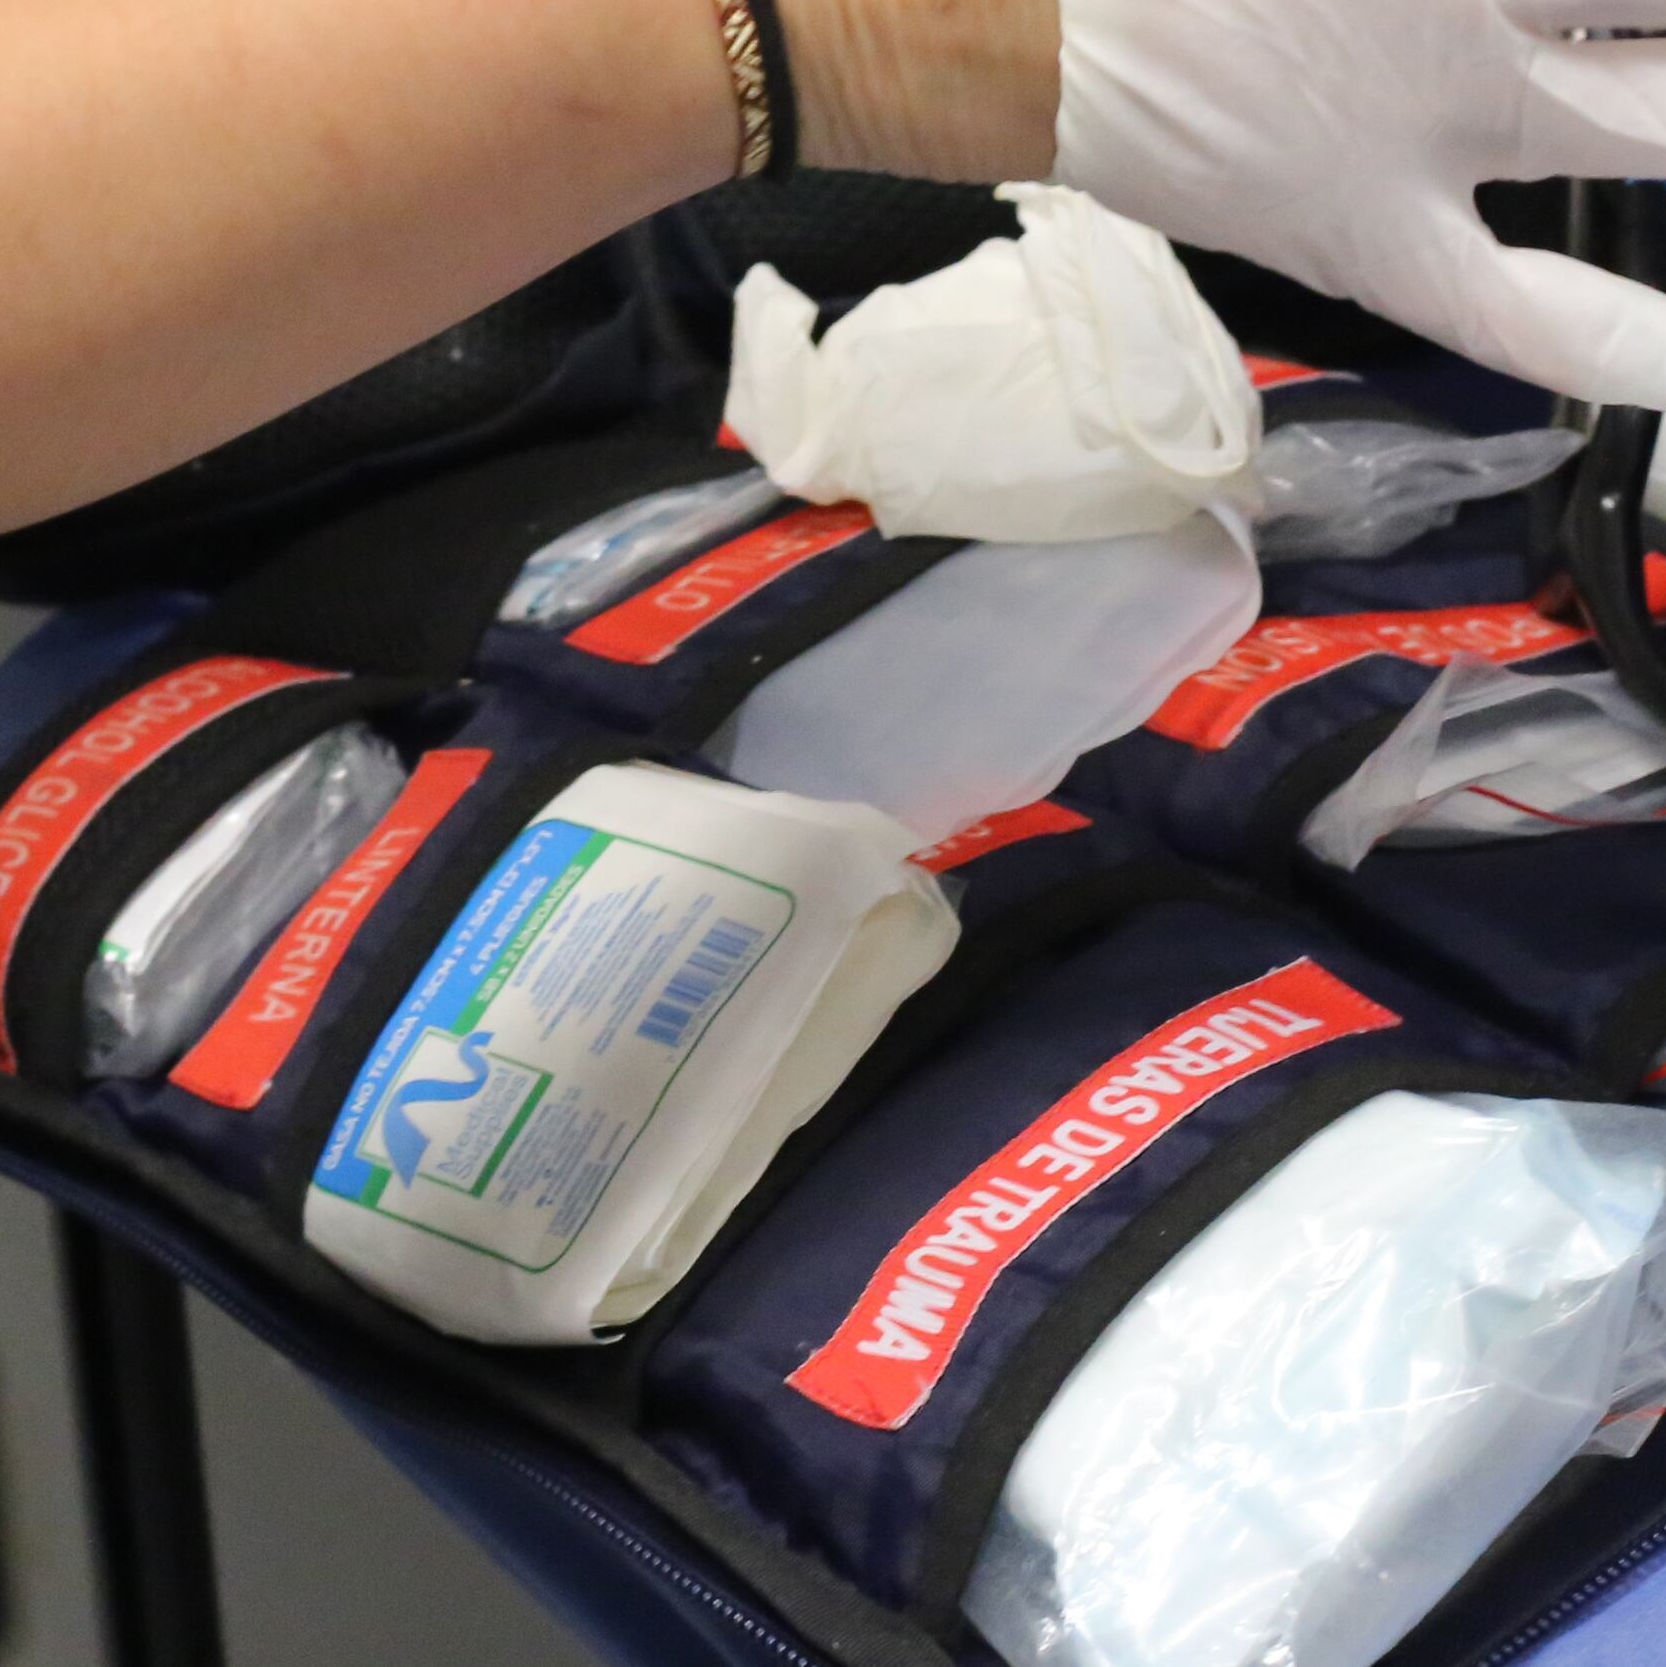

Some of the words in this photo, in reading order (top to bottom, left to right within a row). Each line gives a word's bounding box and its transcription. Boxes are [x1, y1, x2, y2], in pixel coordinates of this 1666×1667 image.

[247, 825, 423, 1023] LINTERNA
[350, 1081, 377, 1115] NO
[1088, 998, 1326, 1127] TIJERAS
[436, 1066, 508, 1173] Medical
[451, 1074, 529, 1183] Supplies
[1017, 1118, 1126, 1184] DE
[855, 1176, 1061, 1362] TRAUMA
